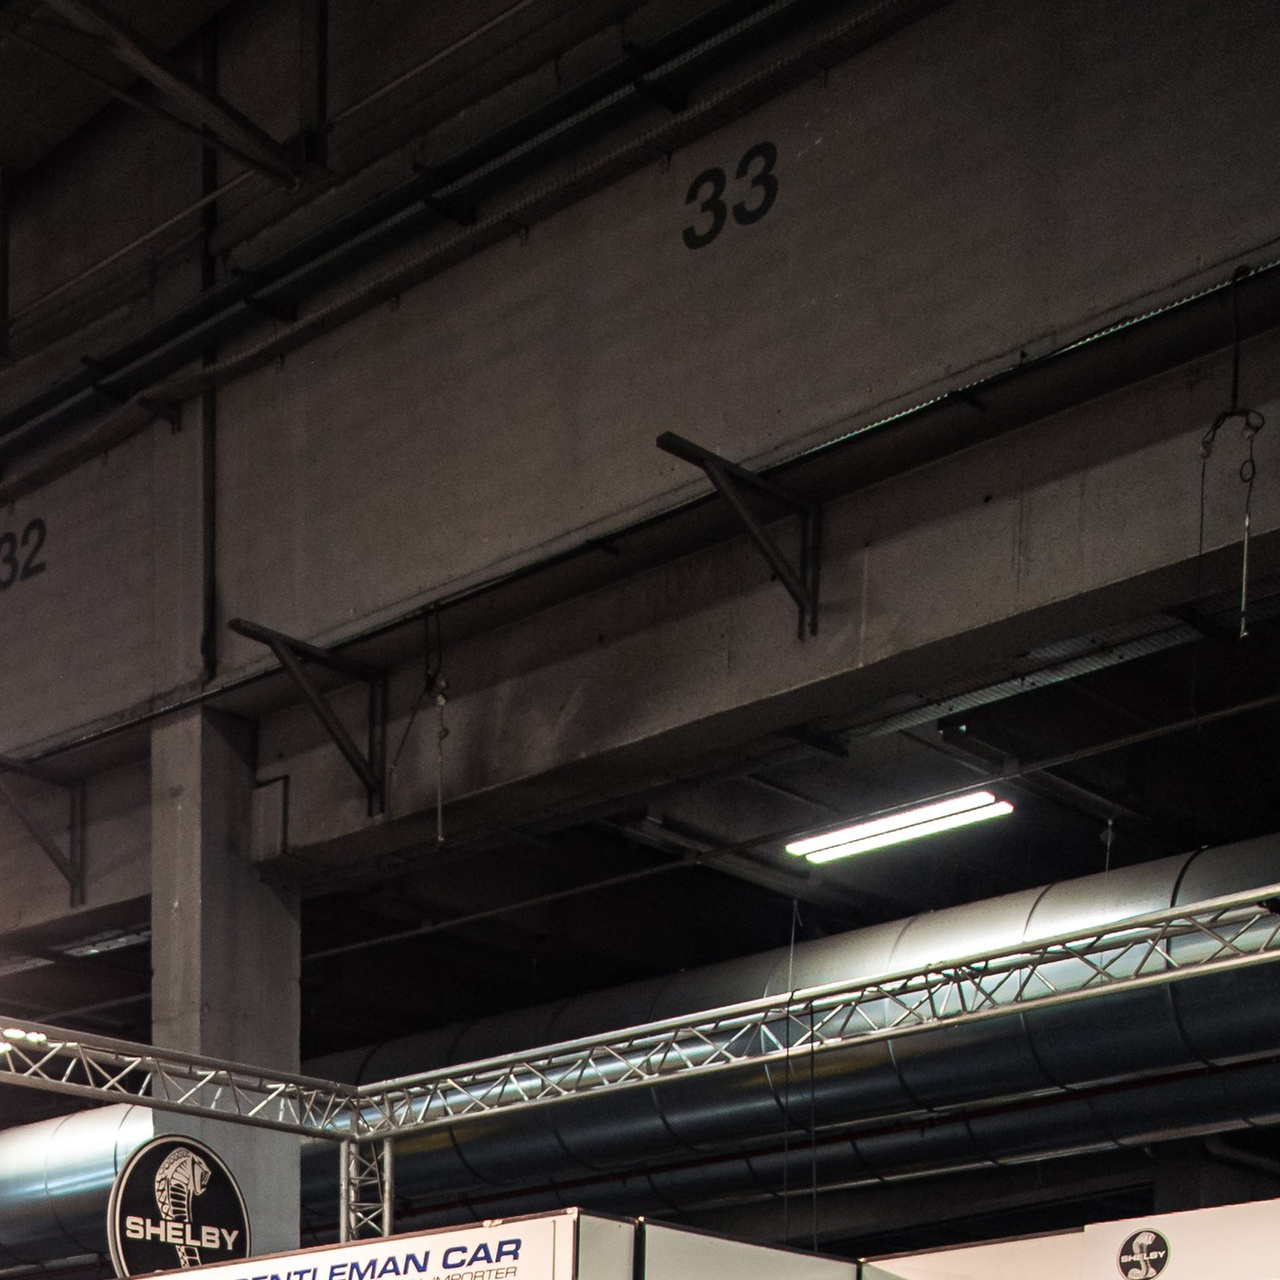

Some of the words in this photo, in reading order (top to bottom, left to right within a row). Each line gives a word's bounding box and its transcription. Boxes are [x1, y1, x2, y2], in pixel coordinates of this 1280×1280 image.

[683, 141, 778, 249] 33
[125, 1215, 239, 1250] SHELBY
[442, 1238, 522, 1270] CAR
[1121, 1250, 1166, 1263] SHELBY
